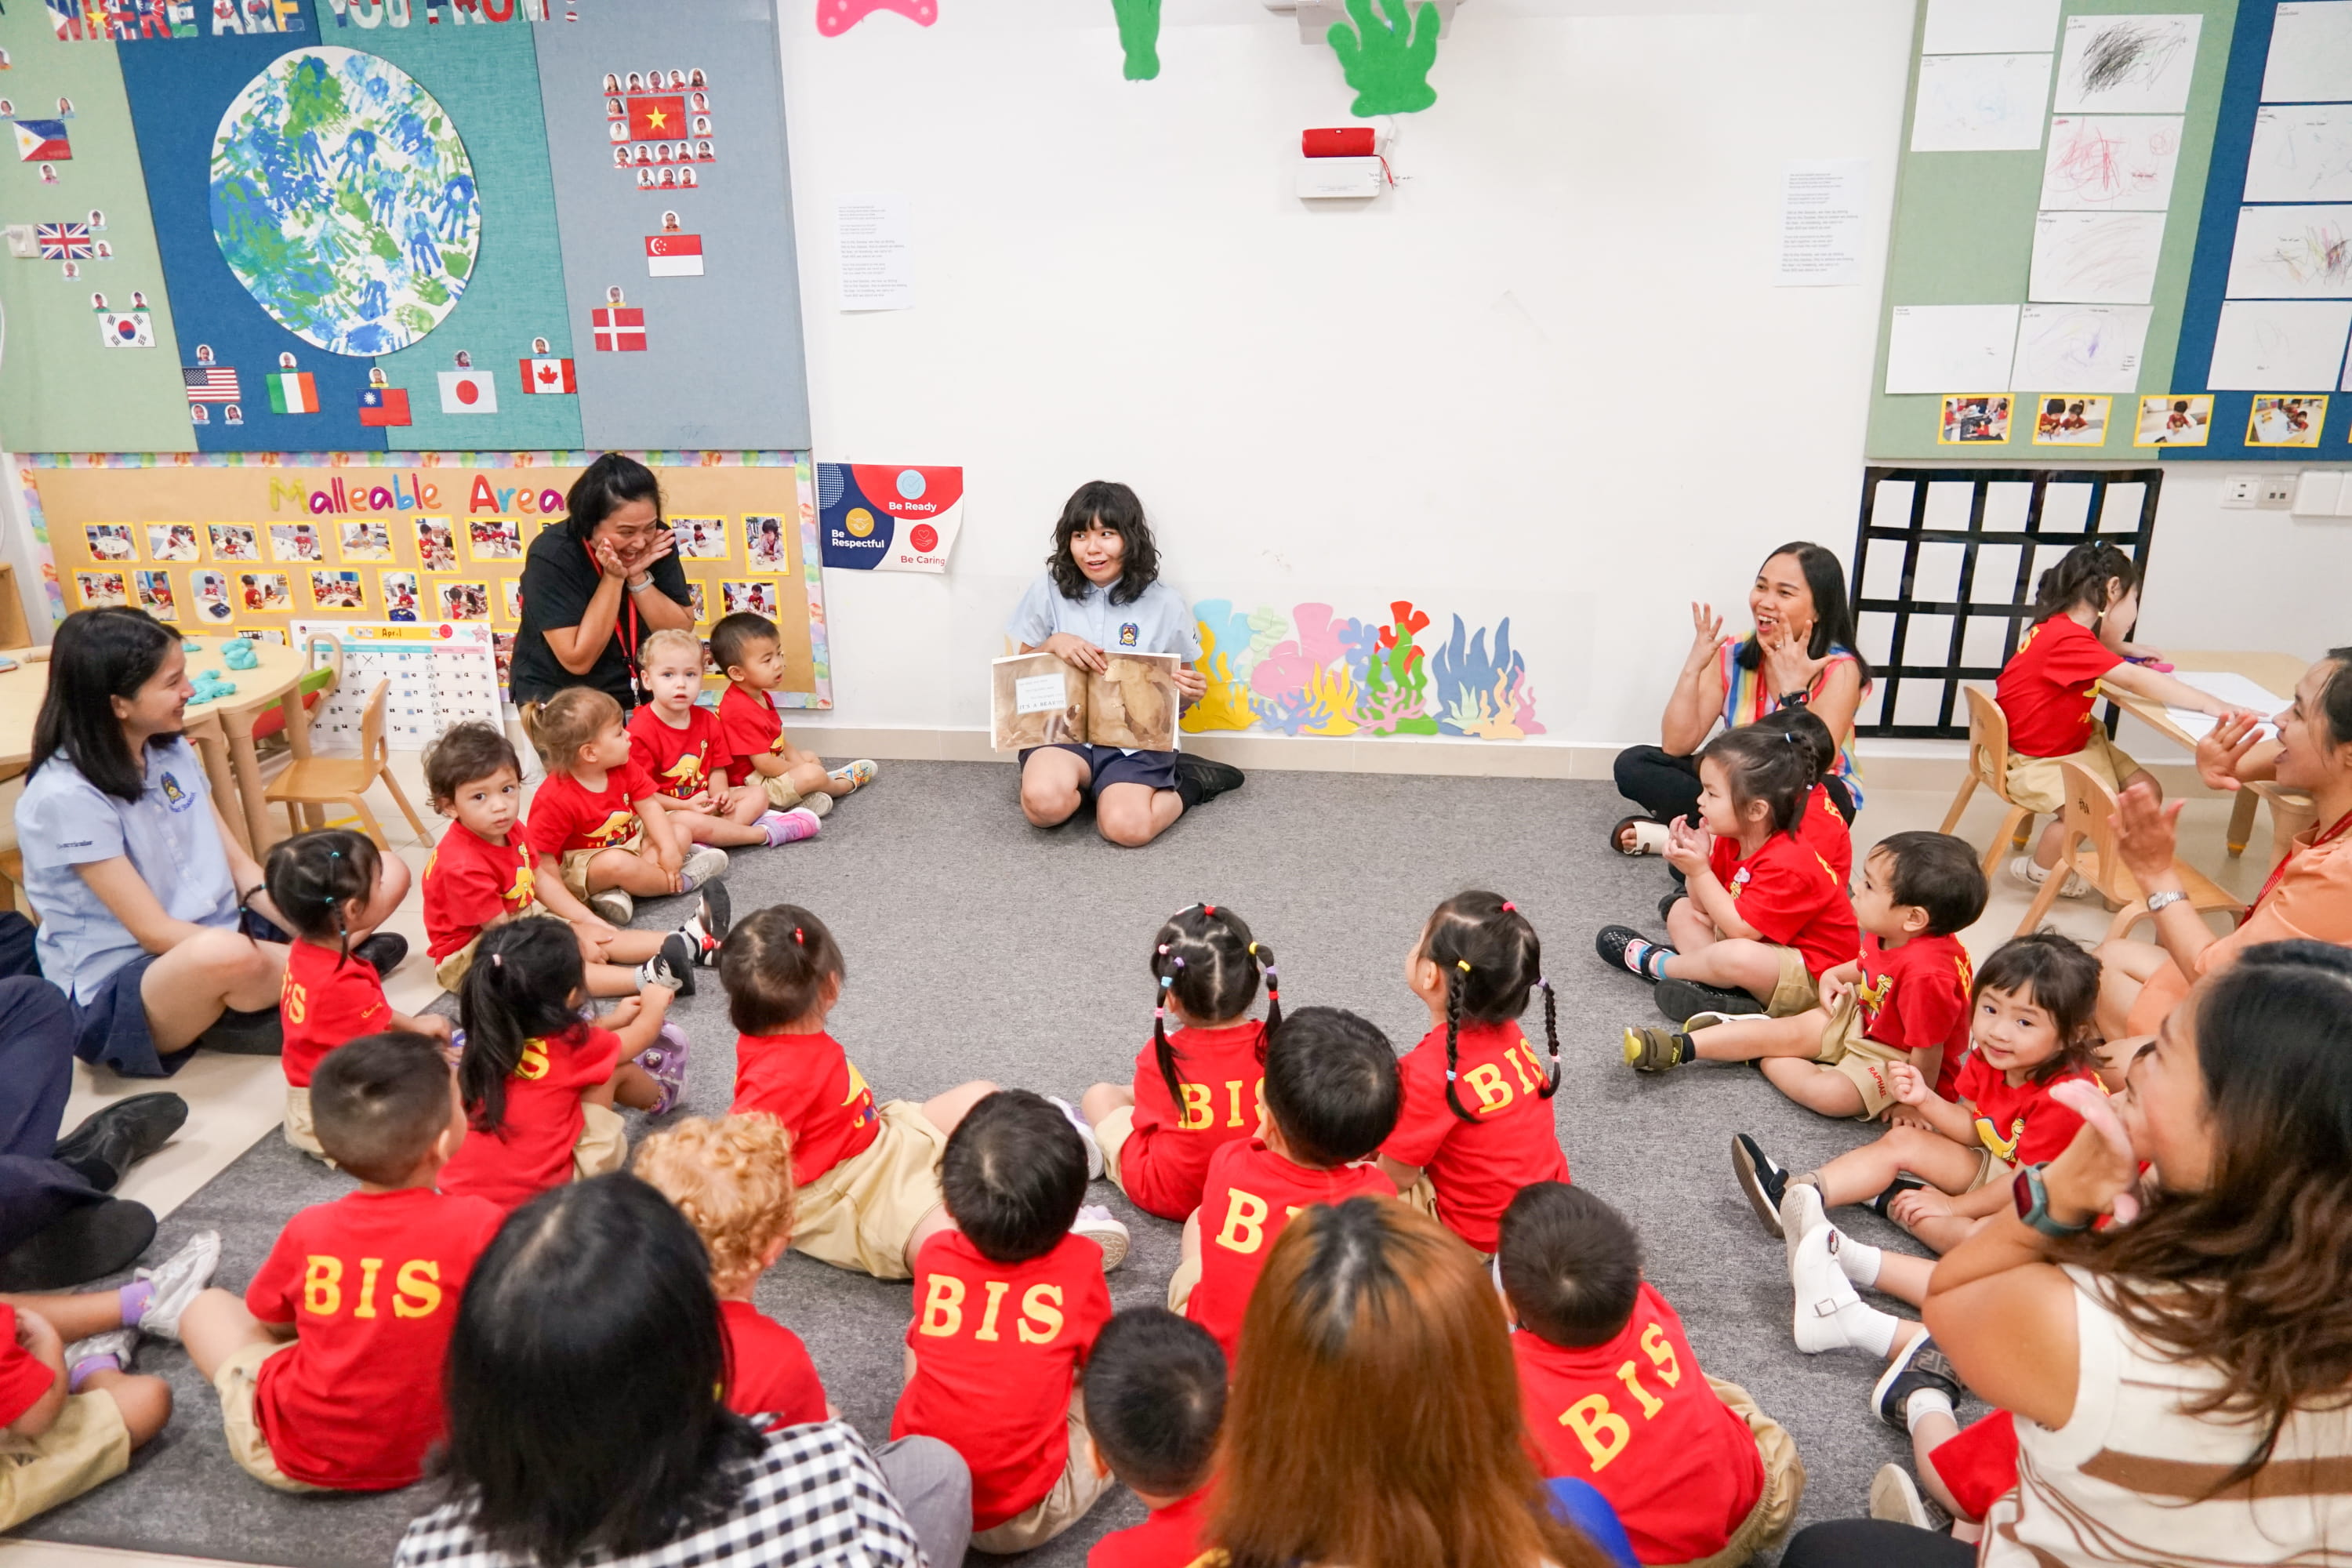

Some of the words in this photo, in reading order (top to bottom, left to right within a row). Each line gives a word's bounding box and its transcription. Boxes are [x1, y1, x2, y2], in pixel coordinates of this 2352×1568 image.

[44, 0, 199, 41] WHERE
[212, 0, 305, 35] ARE
[269, 473, 442, 514] Malleable
[470, 474, 565, 514] Area
[888, 501, 902, 510] Be
[906, 502, 938, 513] Ready
[831, 529, 845, 538] Be
[832, 539, 885, 549] Respectful
[901, 555, 914, 564] Be
[916, 556, 946, 567] Caring
[382, 627, 401, 638] April
[1464, 1038, 1544, 1114] BIS
[1868, 1066, 1887, 1098] RAPHAEL
[305, 1254, 441, 1319] BIS
[918, 1272, 1064, 1345] BIS
[1558, 1322, 1681, 1473] BIS
